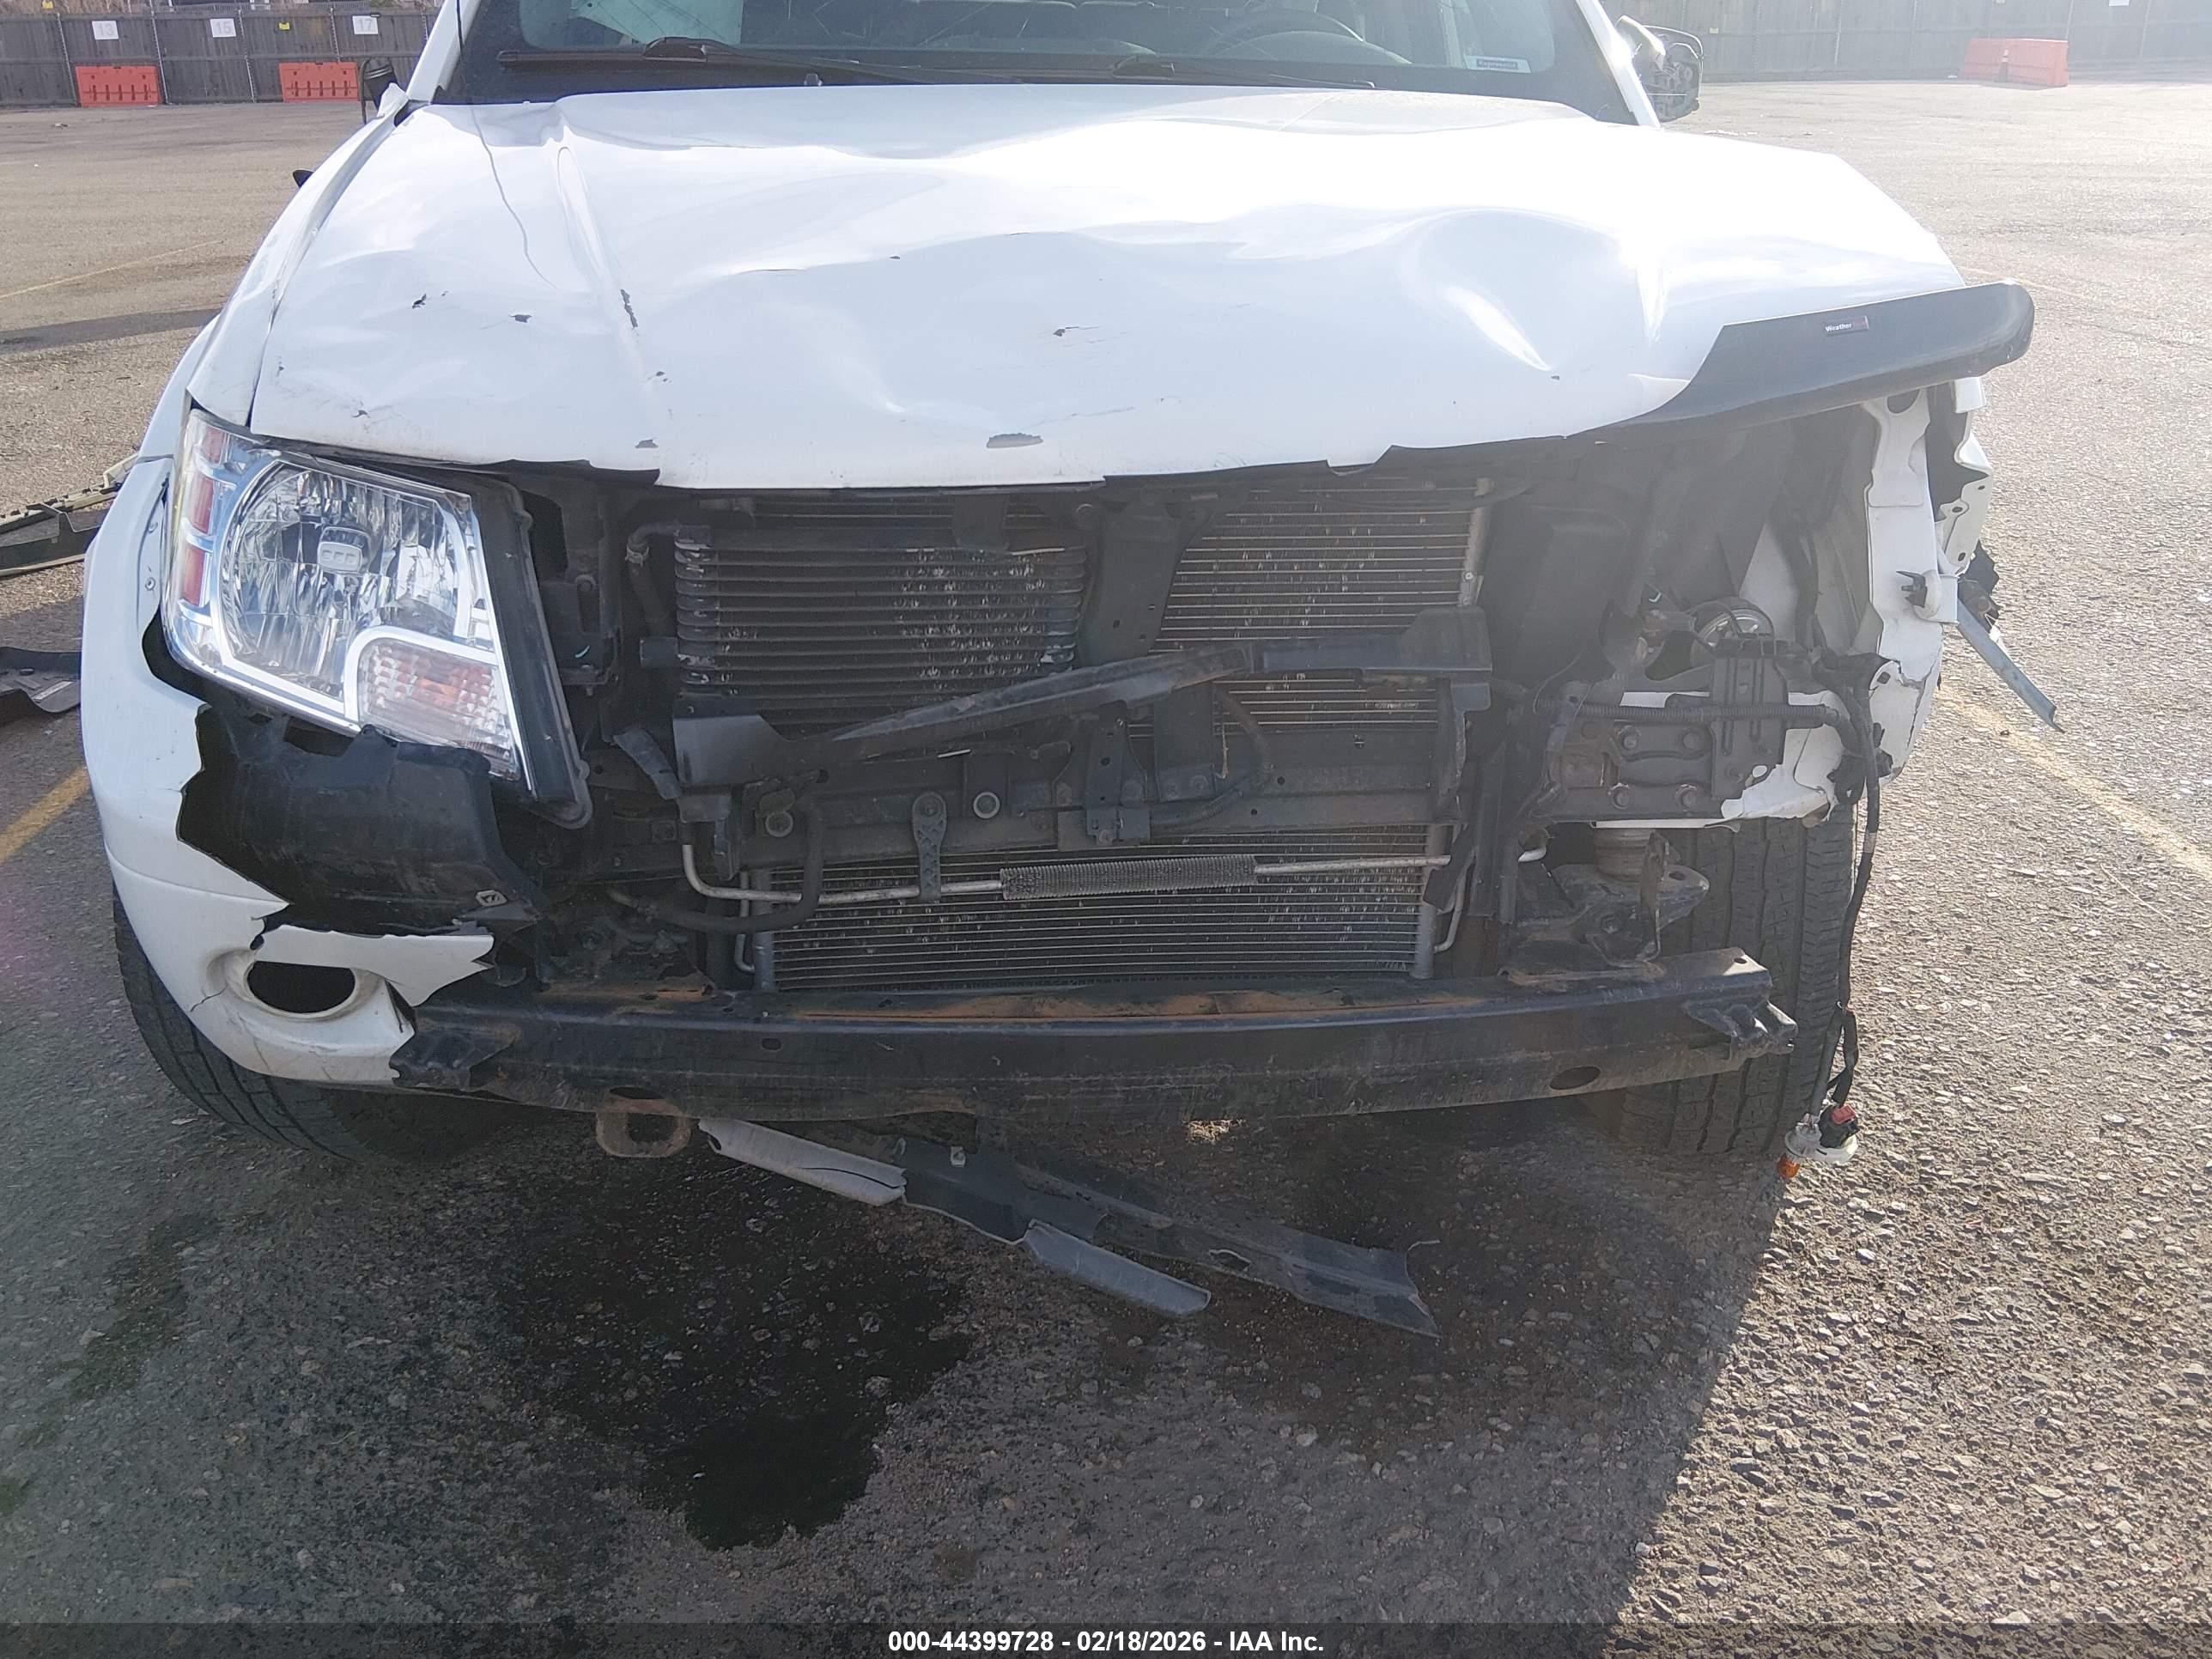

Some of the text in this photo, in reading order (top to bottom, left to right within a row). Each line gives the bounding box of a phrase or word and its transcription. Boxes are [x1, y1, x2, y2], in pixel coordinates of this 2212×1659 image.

[96, 22, 114, 36] 13
[215, 21, 232, 34] 15
[357, 18, 374, 32] 17
